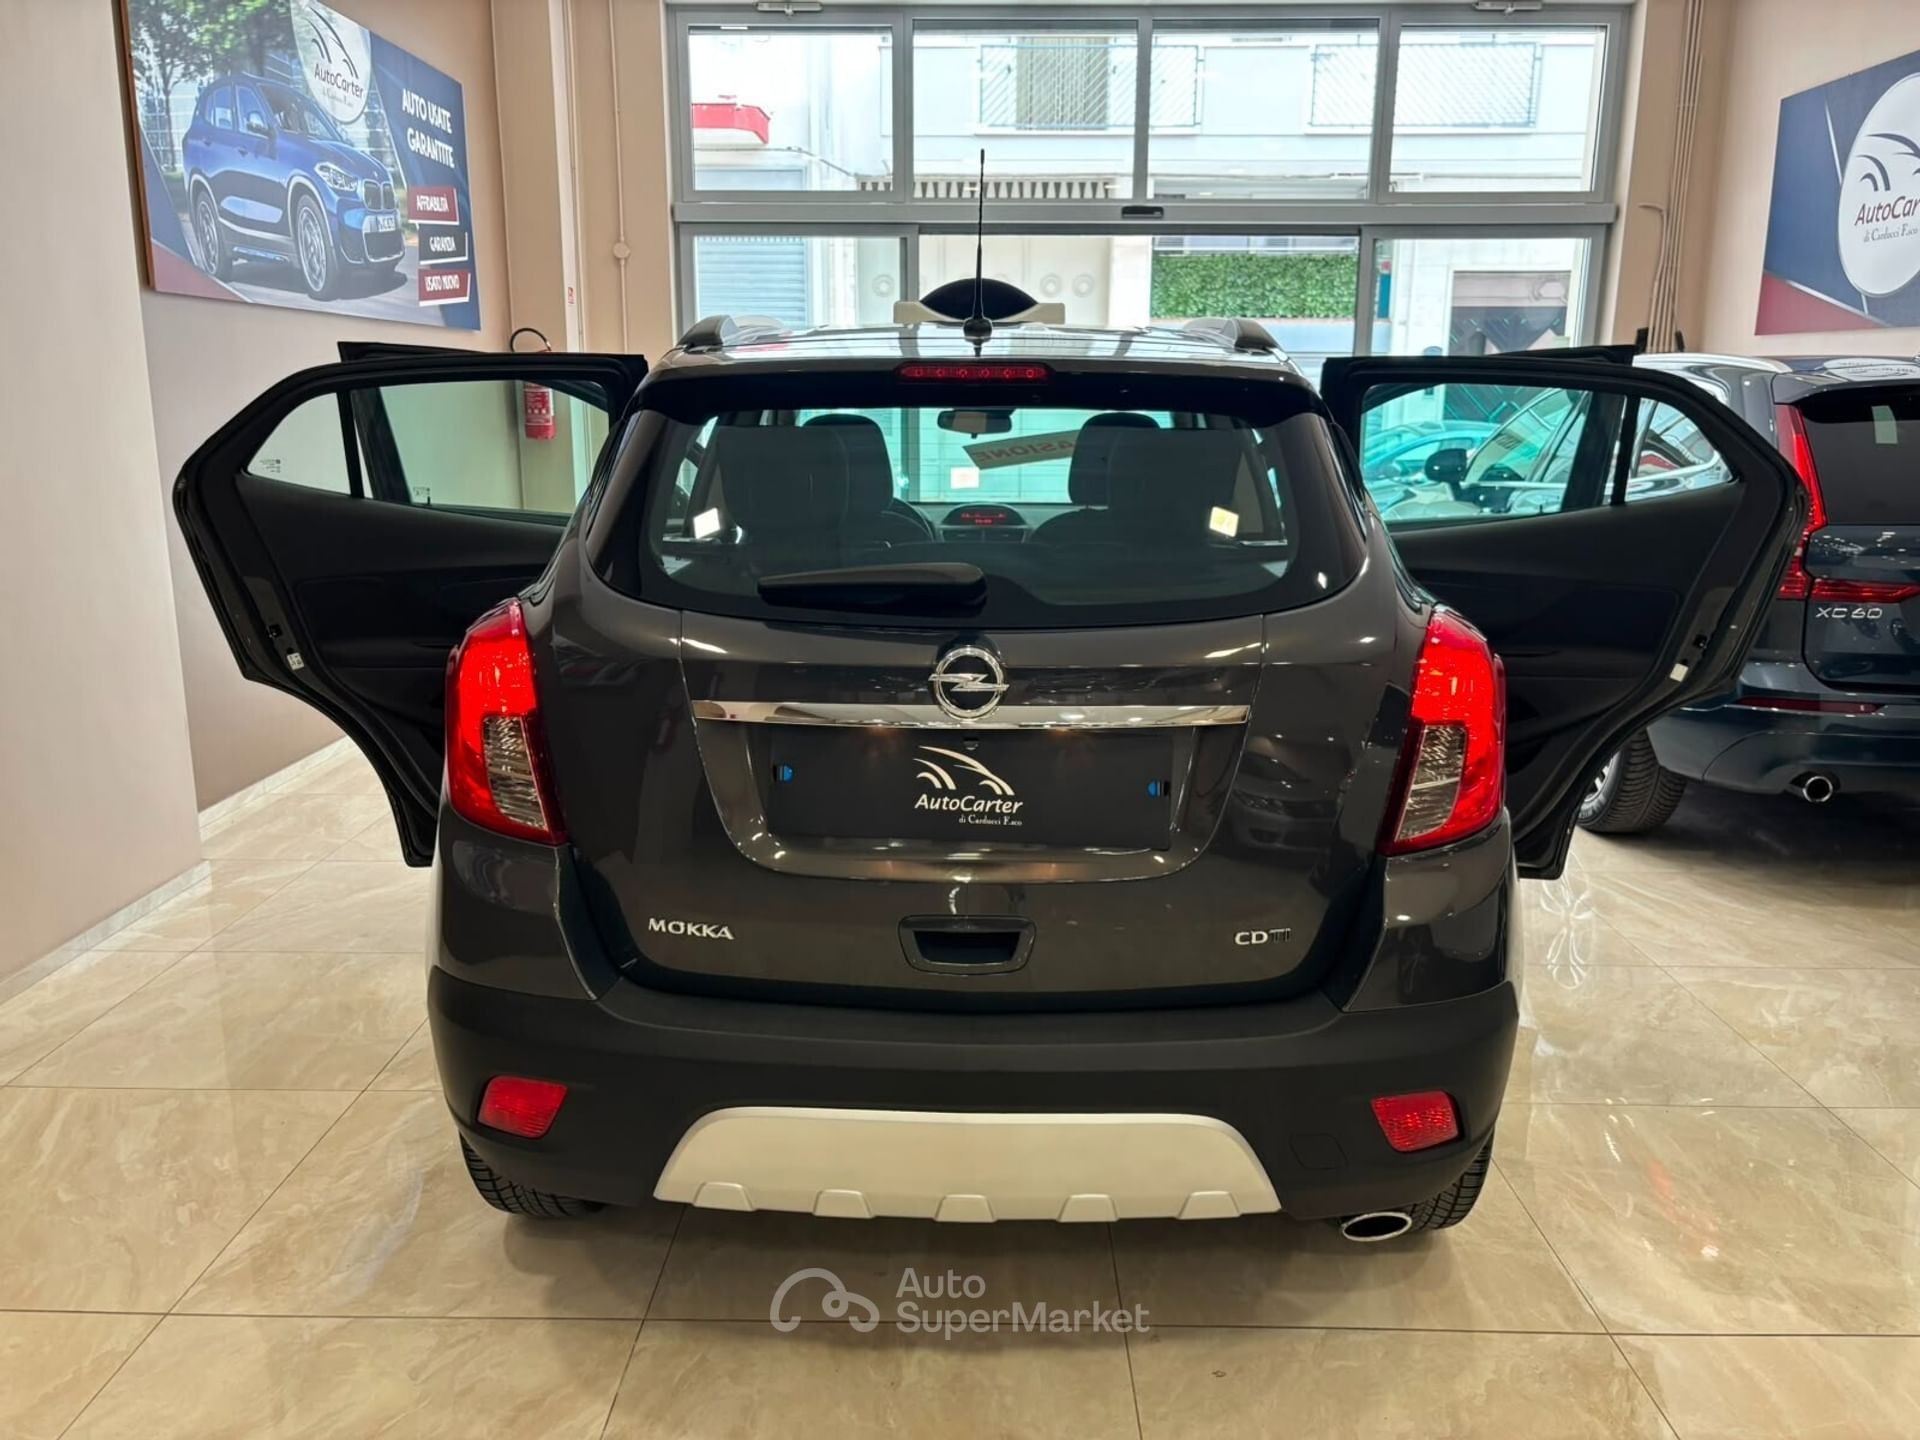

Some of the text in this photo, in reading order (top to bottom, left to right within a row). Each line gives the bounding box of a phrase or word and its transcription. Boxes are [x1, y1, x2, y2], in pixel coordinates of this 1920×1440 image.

[314, 63, 364, 98] AutoCarter
[401, 88, 453, 134] AUTO USATE
[406, 127, 456, 169] GARANTITE
[1854, 195, 1920, 227] AutoCar
[1815, 607, 1883, 619] XC60
[914, 793, 1024, 814] AutoCarter
[958, 814, 966, 824] di
[967, 815, 1001, 825] Carducci
[648, 917, 735, 940] MOKKA
